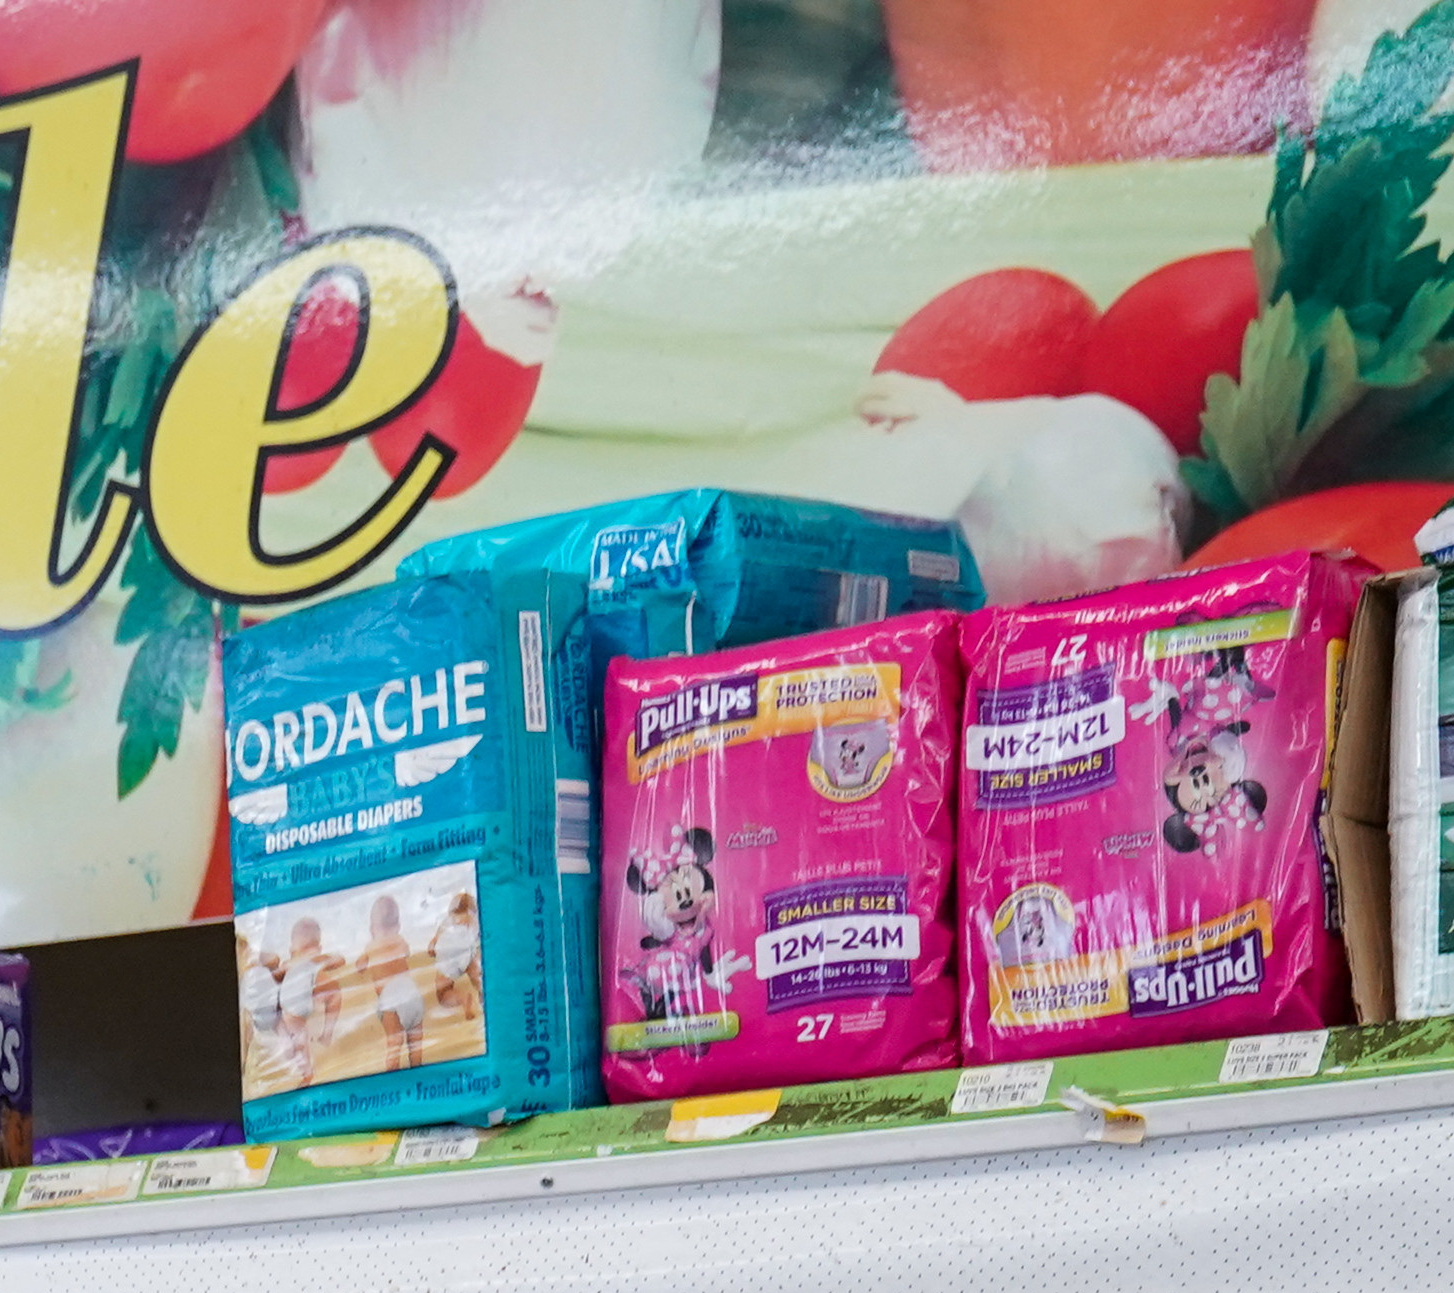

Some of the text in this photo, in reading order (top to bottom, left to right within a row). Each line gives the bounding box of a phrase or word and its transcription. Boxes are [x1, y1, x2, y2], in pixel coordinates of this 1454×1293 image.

[776, 687, 878, 710] PROTECTION
[265, 795, 424, 854] DISPOSABLE DIAPERS
[777, 893, 896, 925] SMALLER SIZE
[771, 926, 904, 966] 12M-24M
[796, 1013, 835, 1042] 27
[527, 1046, 551, 1088] 30
